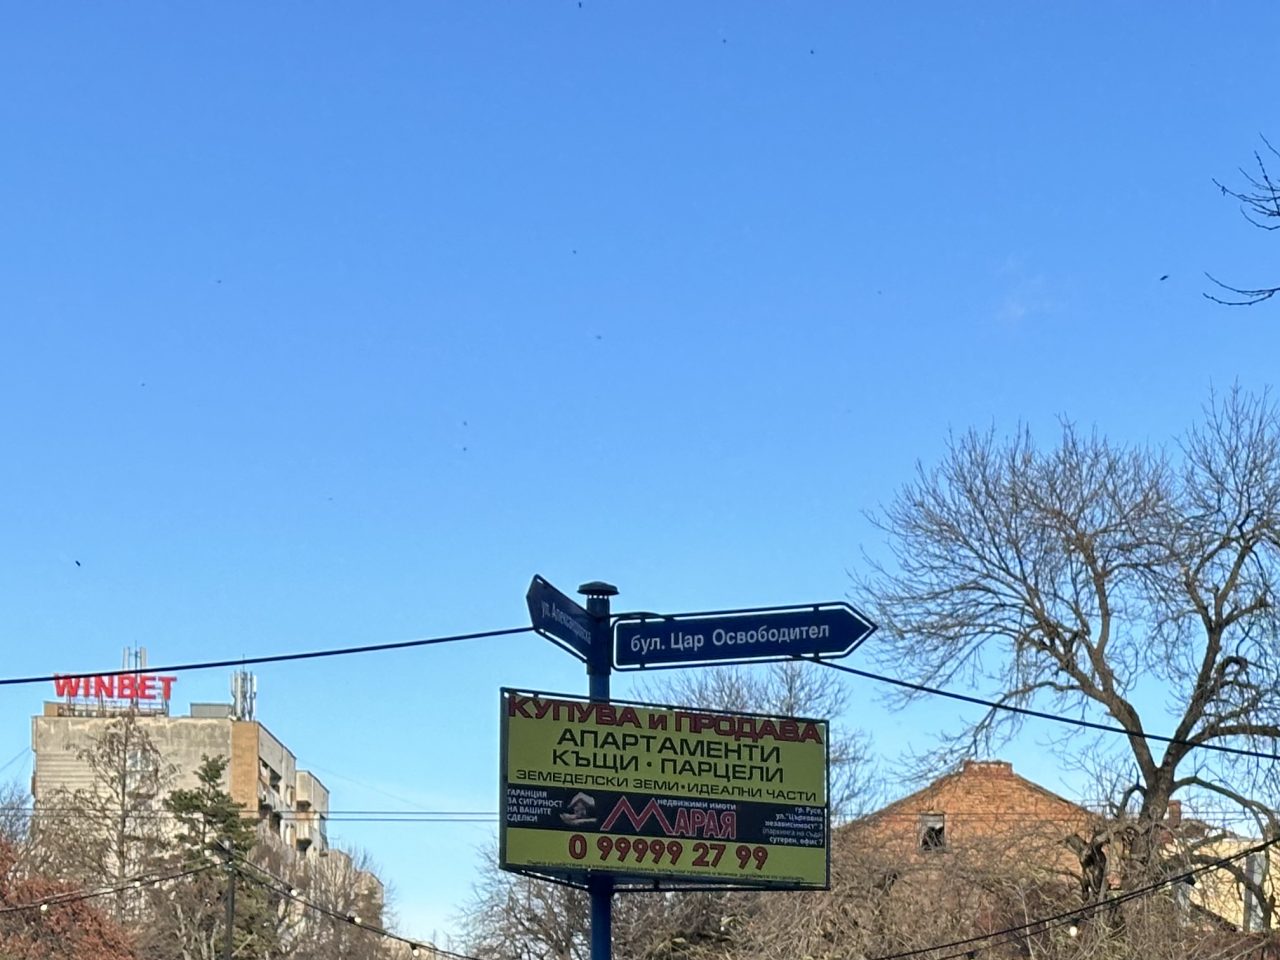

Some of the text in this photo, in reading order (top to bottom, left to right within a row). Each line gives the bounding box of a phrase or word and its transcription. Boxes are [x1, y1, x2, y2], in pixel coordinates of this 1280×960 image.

[630, 624, 829, 654] бул. Цар Освободител
[54, 672, 177, 701] WINBET
[508, 695, 823, 744] КУПУВА и ПРОДАВА
[557, 728, 781, 764] АПАРТАМЕНТИ
[552, 749, 783, 783] КЪЩИ ПАРЦЕЛИ
[507, 789, 548, 798] ГАРАНЦИЯ
[516, 769, 629, 788] ЗЕМЕДЕЛСКИ
[766, 791, 816, 802] ЧАСТИ
[507, 805, 551, 815] НА ВАШИТЕ
[507, 814, 538, 822] СДЕЛКИ
[518, 798, 563, 808] СИГУРНОСТ
[600, 795, 736, 839] МАРАЯ
[657, 799, 736, 811] недвижими имоти
[568, 834, 588, 860] 0
[597, 836, 683, 866] 99999
[692, 842, 726, 868] 27
[736, 845, 768, 871] 99
